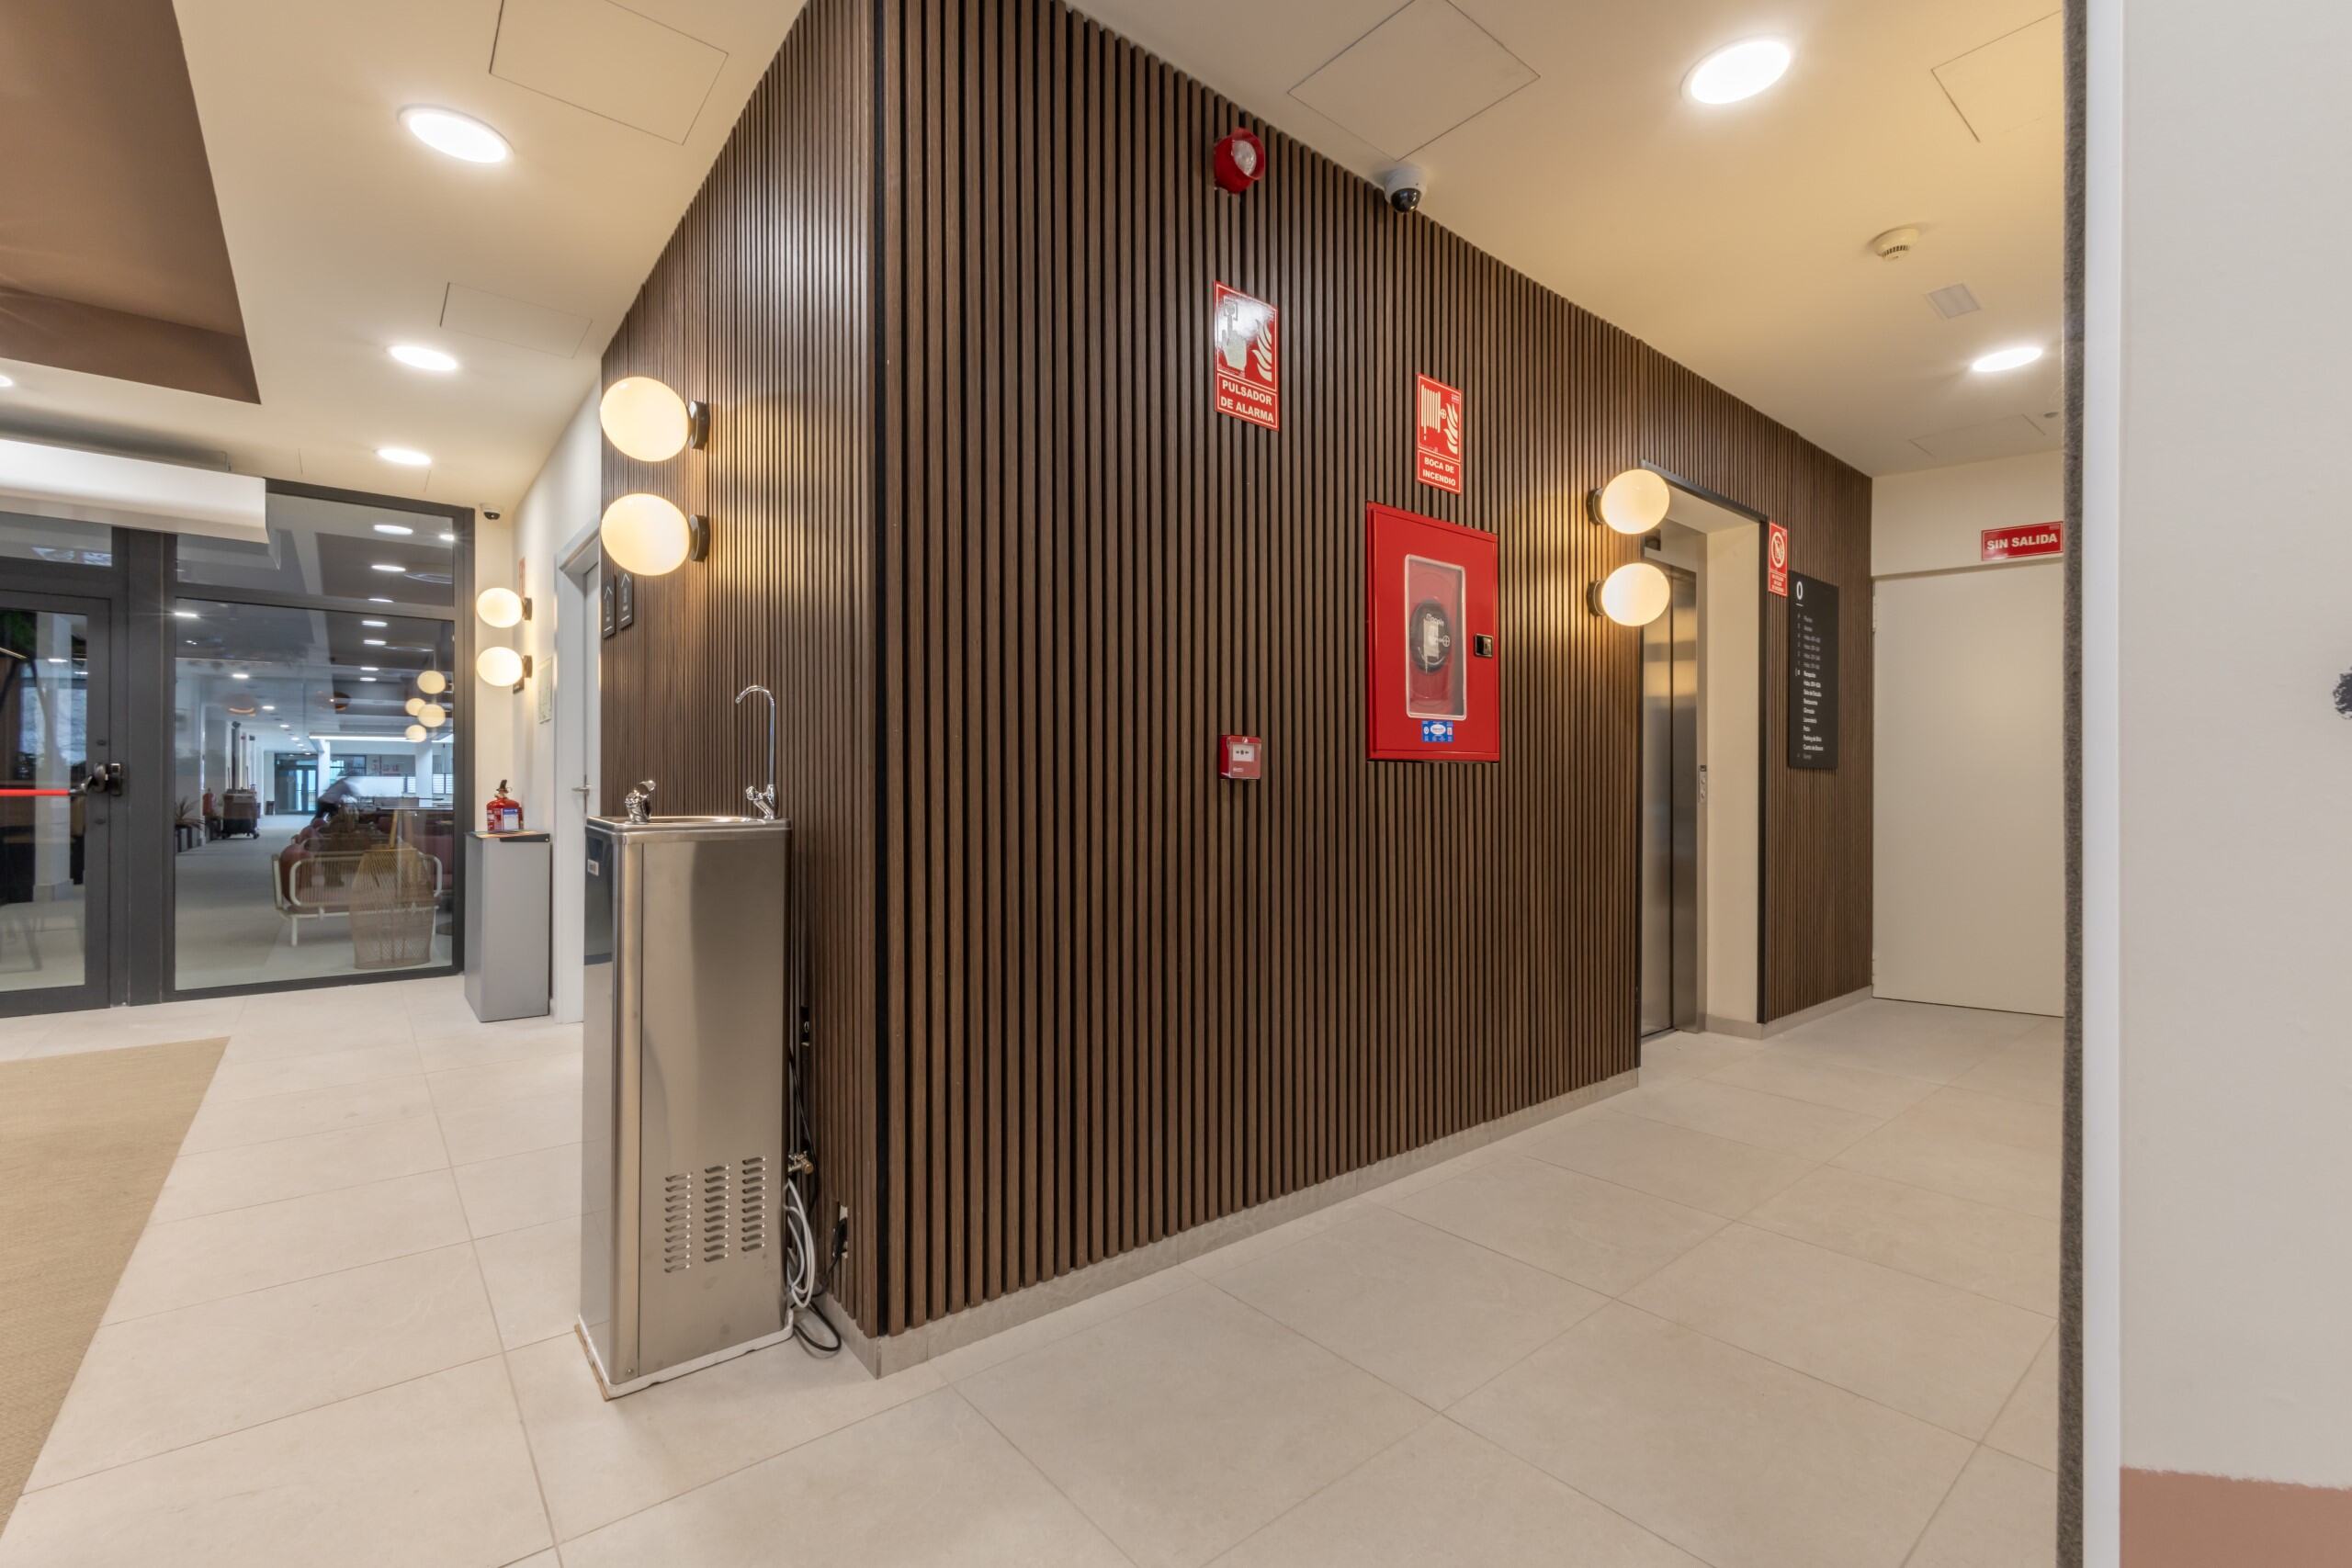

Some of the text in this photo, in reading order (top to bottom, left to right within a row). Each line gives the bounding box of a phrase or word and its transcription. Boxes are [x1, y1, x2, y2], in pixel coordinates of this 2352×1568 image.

[1222, 379, 1272, 406] PULSADOR
[1220, 396, 1273, 423] DE ALARMA
[1424, 457, 1454, 474] BOCA DE
[1423, 469, 1455, 486] INCENDIO
[1986, 533, 2058, 550] SIN SALIDA
